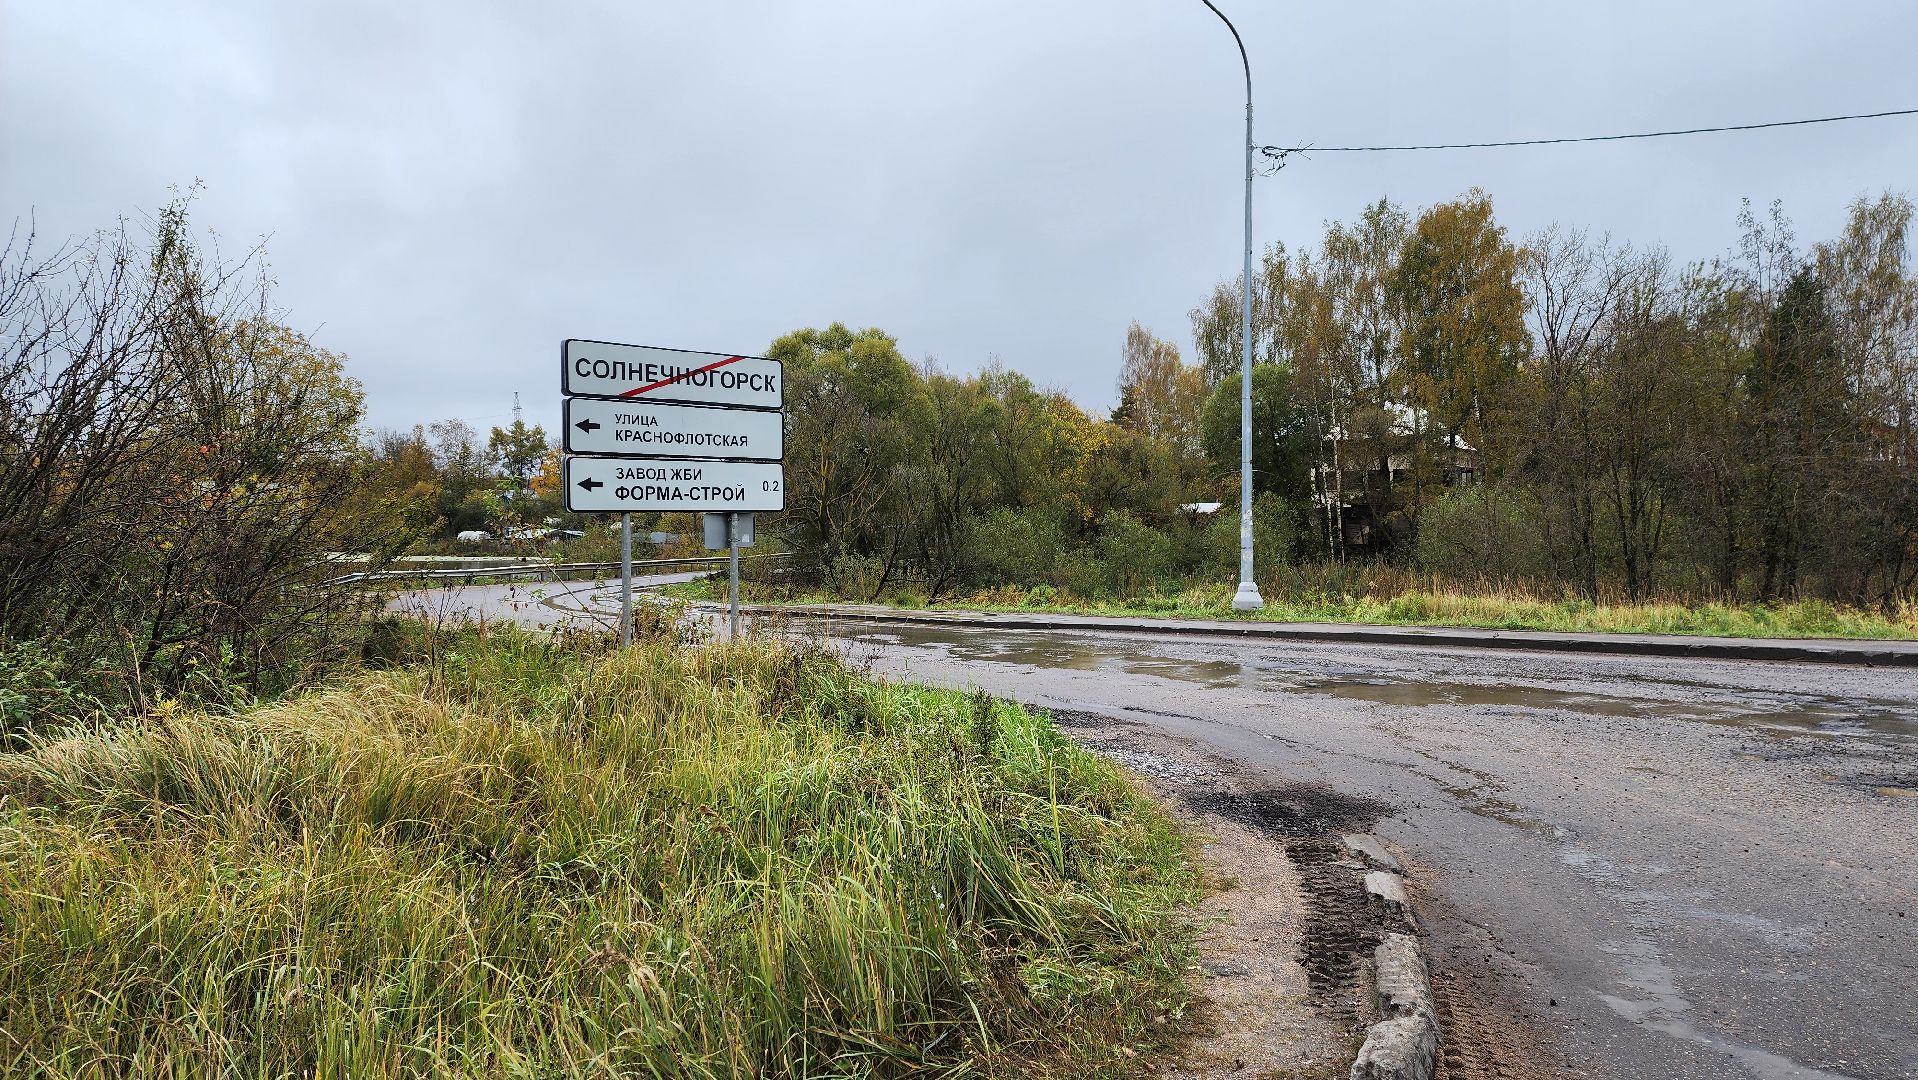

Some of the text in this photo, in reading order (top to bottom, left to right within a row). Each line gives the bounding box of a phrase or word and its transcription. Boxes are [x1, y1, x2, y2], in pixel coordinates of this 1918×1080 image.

[575, 357, 776, 393] СОЛНЕЧНОГОРСК
[615, 413, 658, 427] УЛИЦА
[615, 429, 748, 447] КРАСНОФЛОТСКАЯ
[615, 467, 702, 481] ЗАВОД ЖБИ
[615, 484, 745, 501] ФОРМА-СТРОЙ
[762, 480, 780, 492] 0.2
